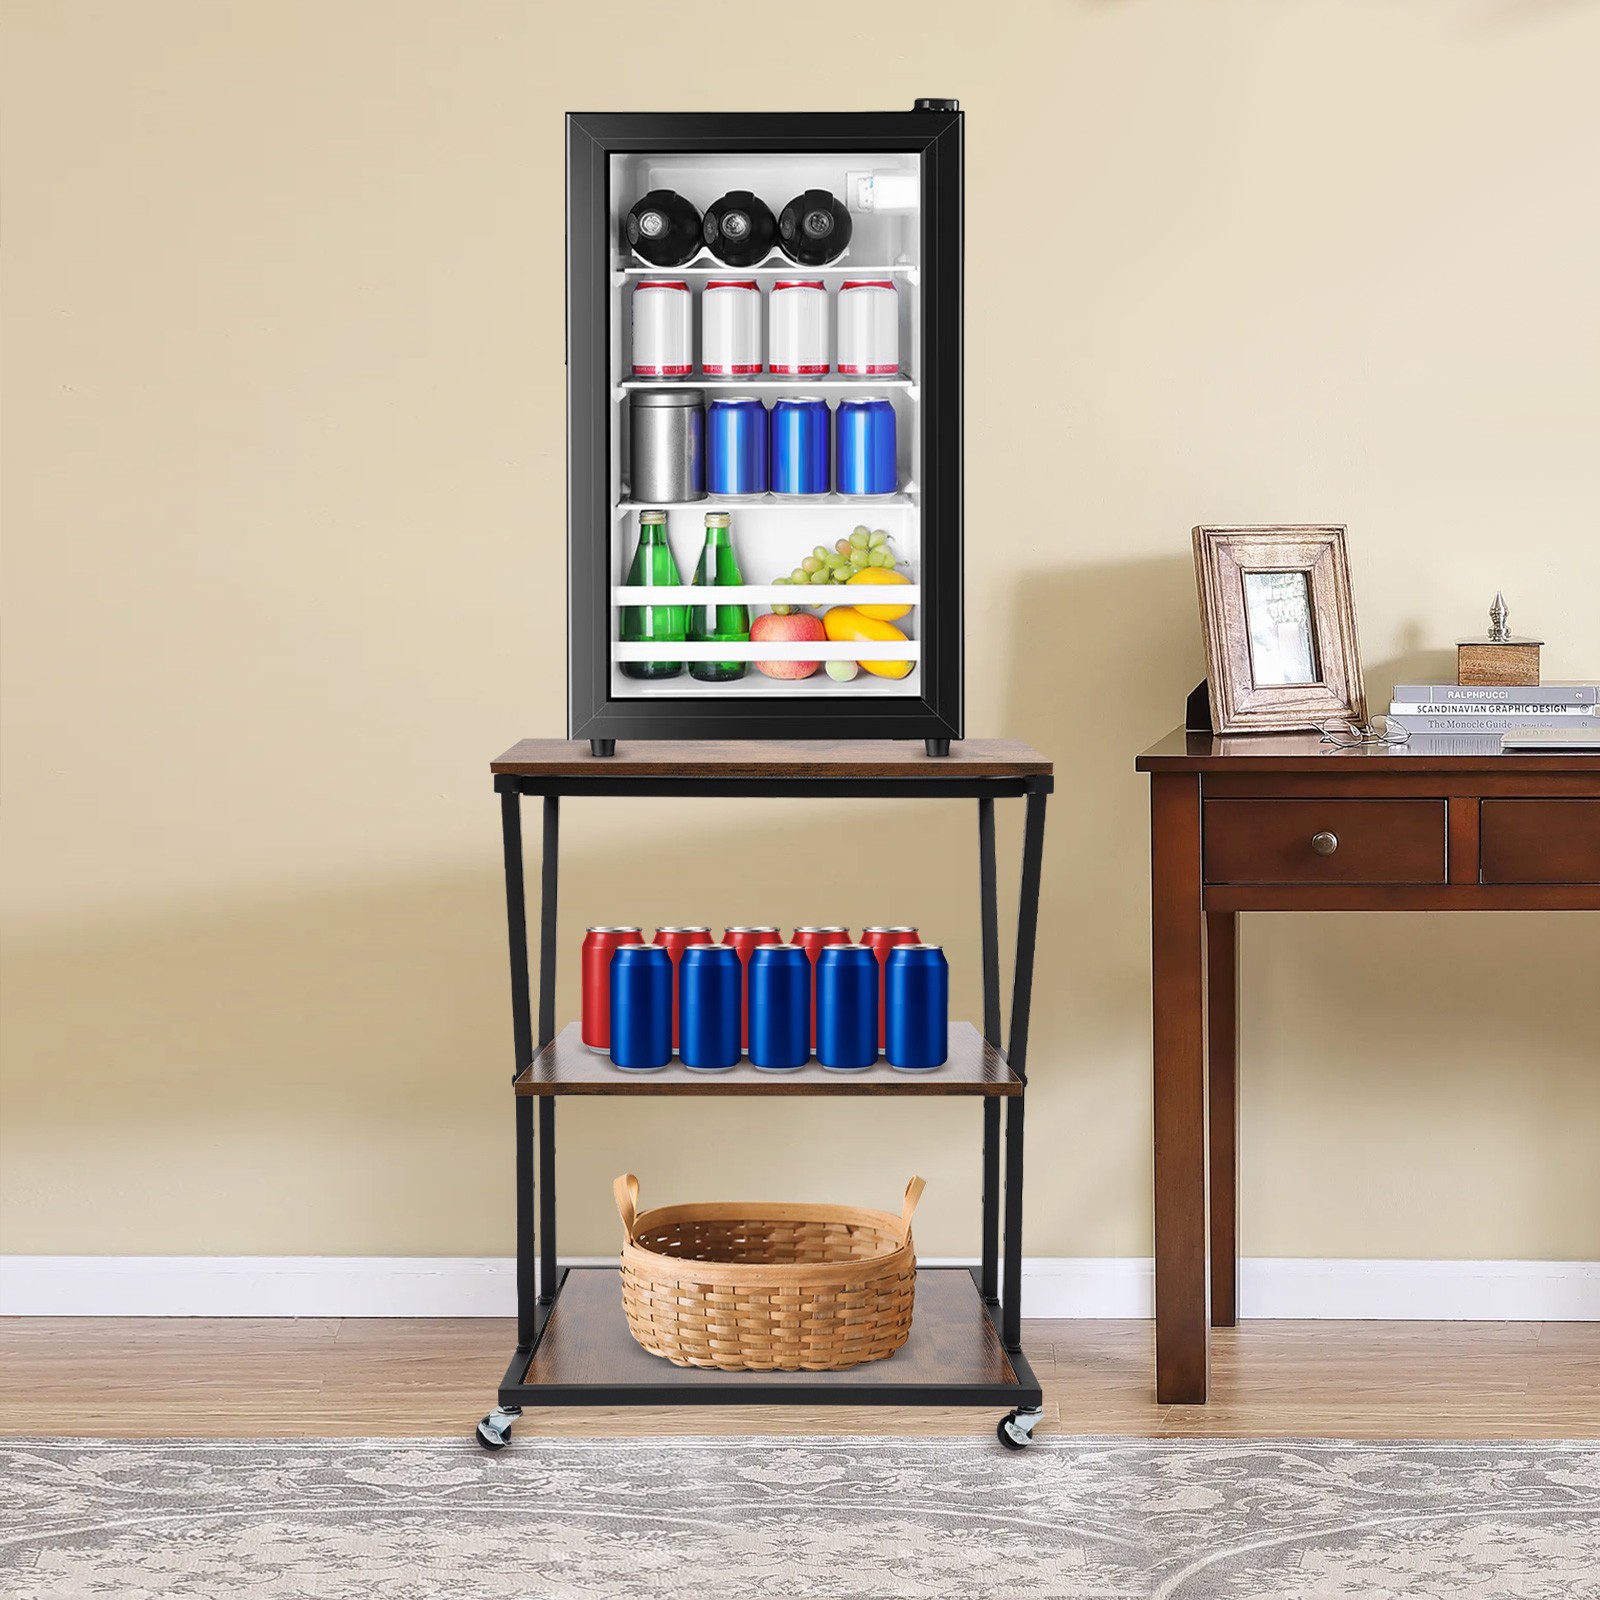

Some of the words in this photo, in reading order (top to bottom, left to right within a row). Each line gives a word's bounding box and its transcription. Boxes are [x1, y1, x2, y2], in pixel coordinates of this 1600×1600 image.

[1447, 691, 1508, 699] RALPHPUCCI
[1417, 705, 1487, 713] SCANDINAVIAN
[1488, 705, 1530, 713] GRAPHIC
[1532, 704, 1567, 713] DESIGN
[1428, 720, 1445, 728] The
[1447, 720, 1484, 728] Monocle
[1486, 719, 1512, 729] Guide
